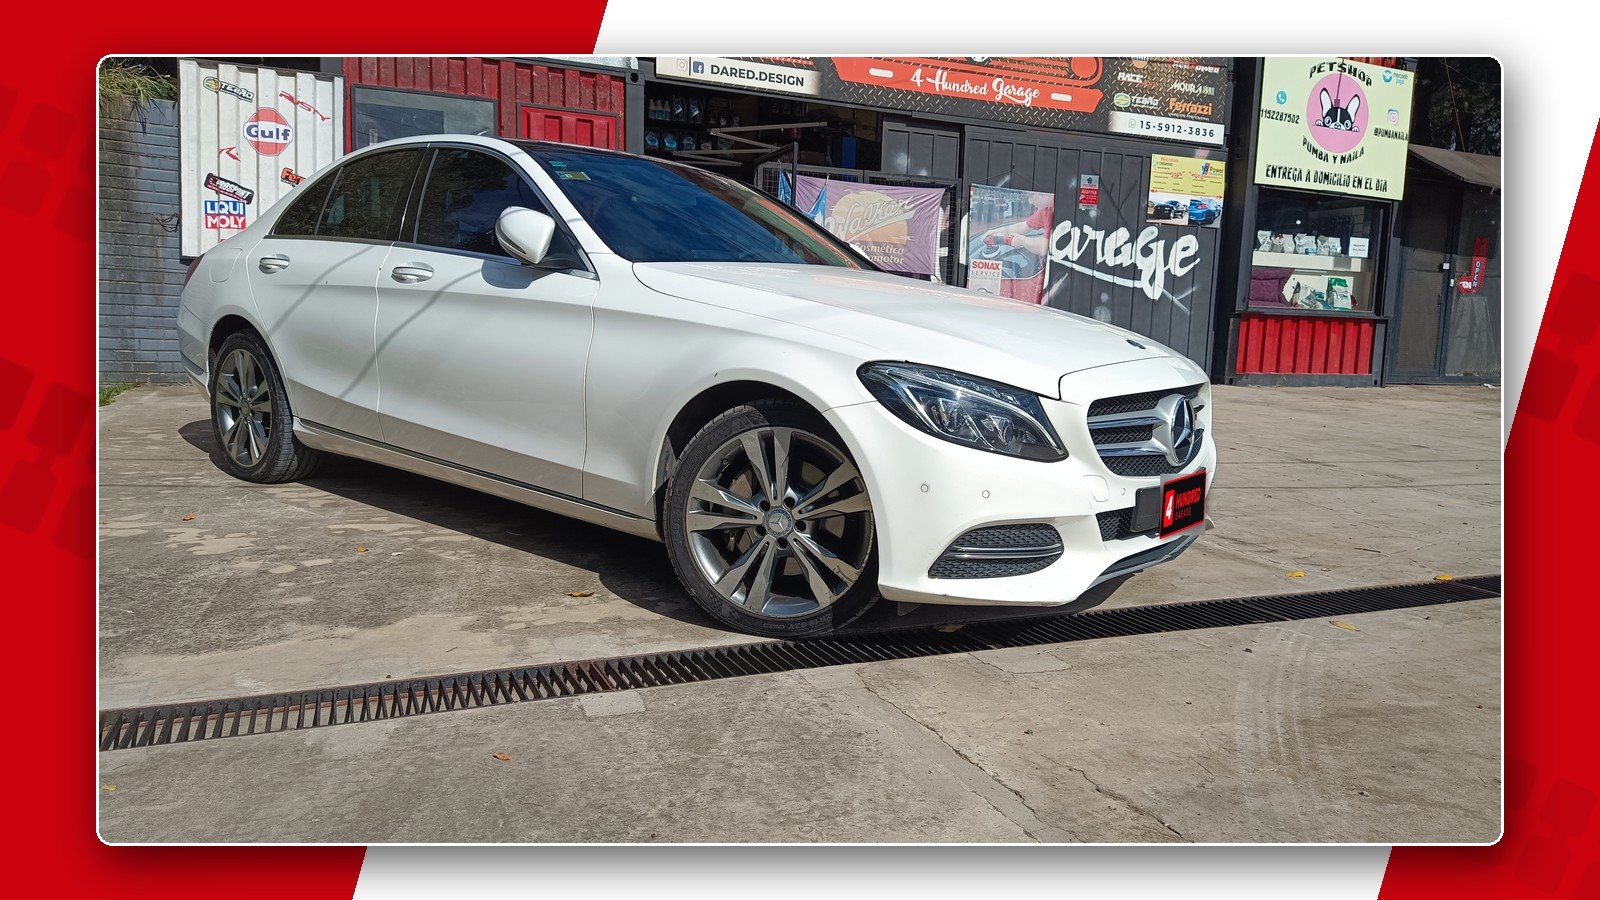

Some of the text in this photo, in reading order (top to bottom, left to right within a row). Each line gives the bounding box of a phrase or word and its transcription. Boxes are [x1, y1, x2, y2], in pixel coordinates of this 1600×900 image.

[710, 64, 805, 87] DARED.DESIGN
[1309, 61, 1373, 87] PETSHOP
[909, 68, 1041, 107] 4 Hundred Garage
[1169, 97, 1213, 115] Ferrazzi
[246, 124, 291, 141] Gulf
[1139, 120, 1215, 138] 15-5912-3836
[1302, 136, 1330, 163] PUMBA
[1332, 155, 1338, 165] Y
[1265, 164, 1302, 182] ENTREGA
[1305, 169, 1311, 183] A
[1313, 170, 1350, 188] DOMICILIO
[1352, 175, 1362, 189] EN
[1364, 176, 1373, 190] EL
[206, 201, 244, 215] LIQUI
[206, 216, 246, 229] MOLY
[868, 254, 905, 265] omotor
[972, 260, 1001, 271] SONAX
[1048, 219, 1201, 301] arage
[971, 270, 1001, 278] SERVICE
[1472, 261, 1481, 288] OPEN
